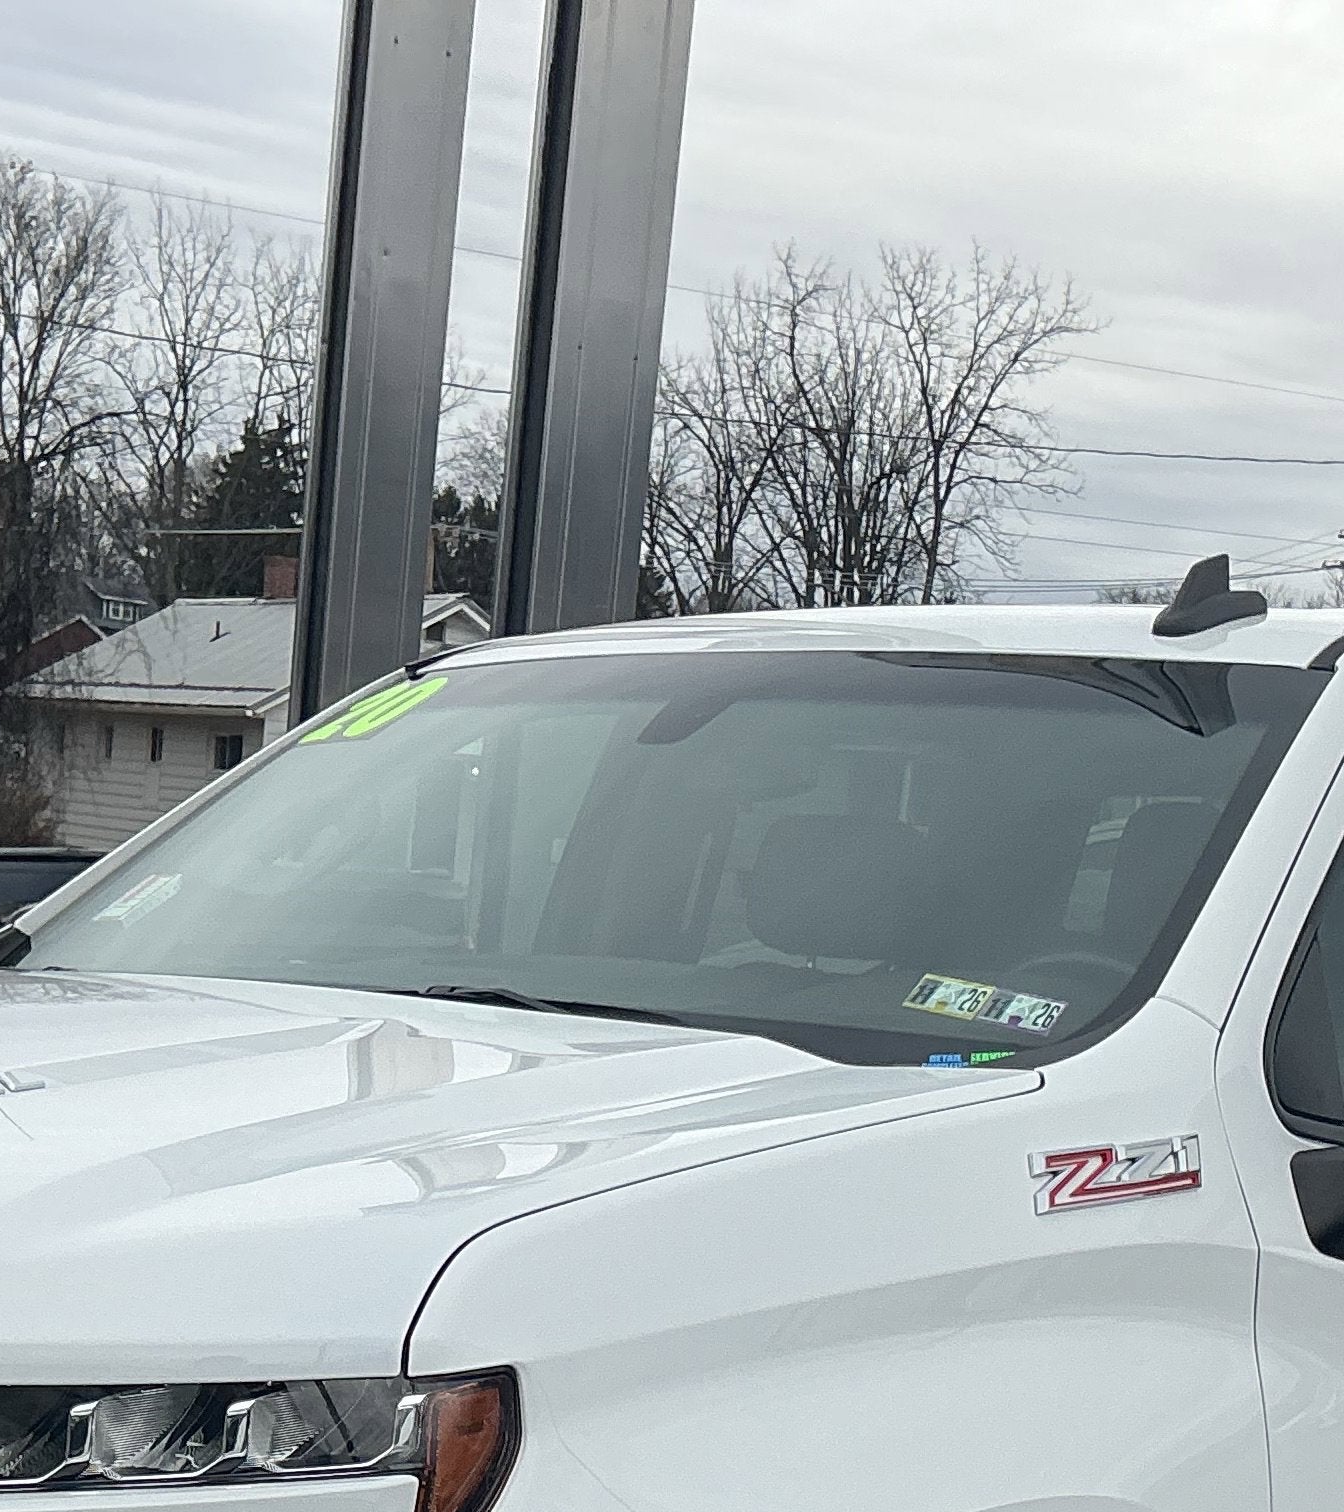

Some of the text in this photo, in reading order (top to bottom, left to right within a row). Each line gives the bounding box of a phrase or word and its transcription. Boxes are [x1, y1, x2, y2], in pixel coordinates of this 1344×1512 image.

[957, 988, 988, 1013] 26
[1032, 1002, 1060, 1029] 26
[1027, 1132, 1203, 1217] Z71
